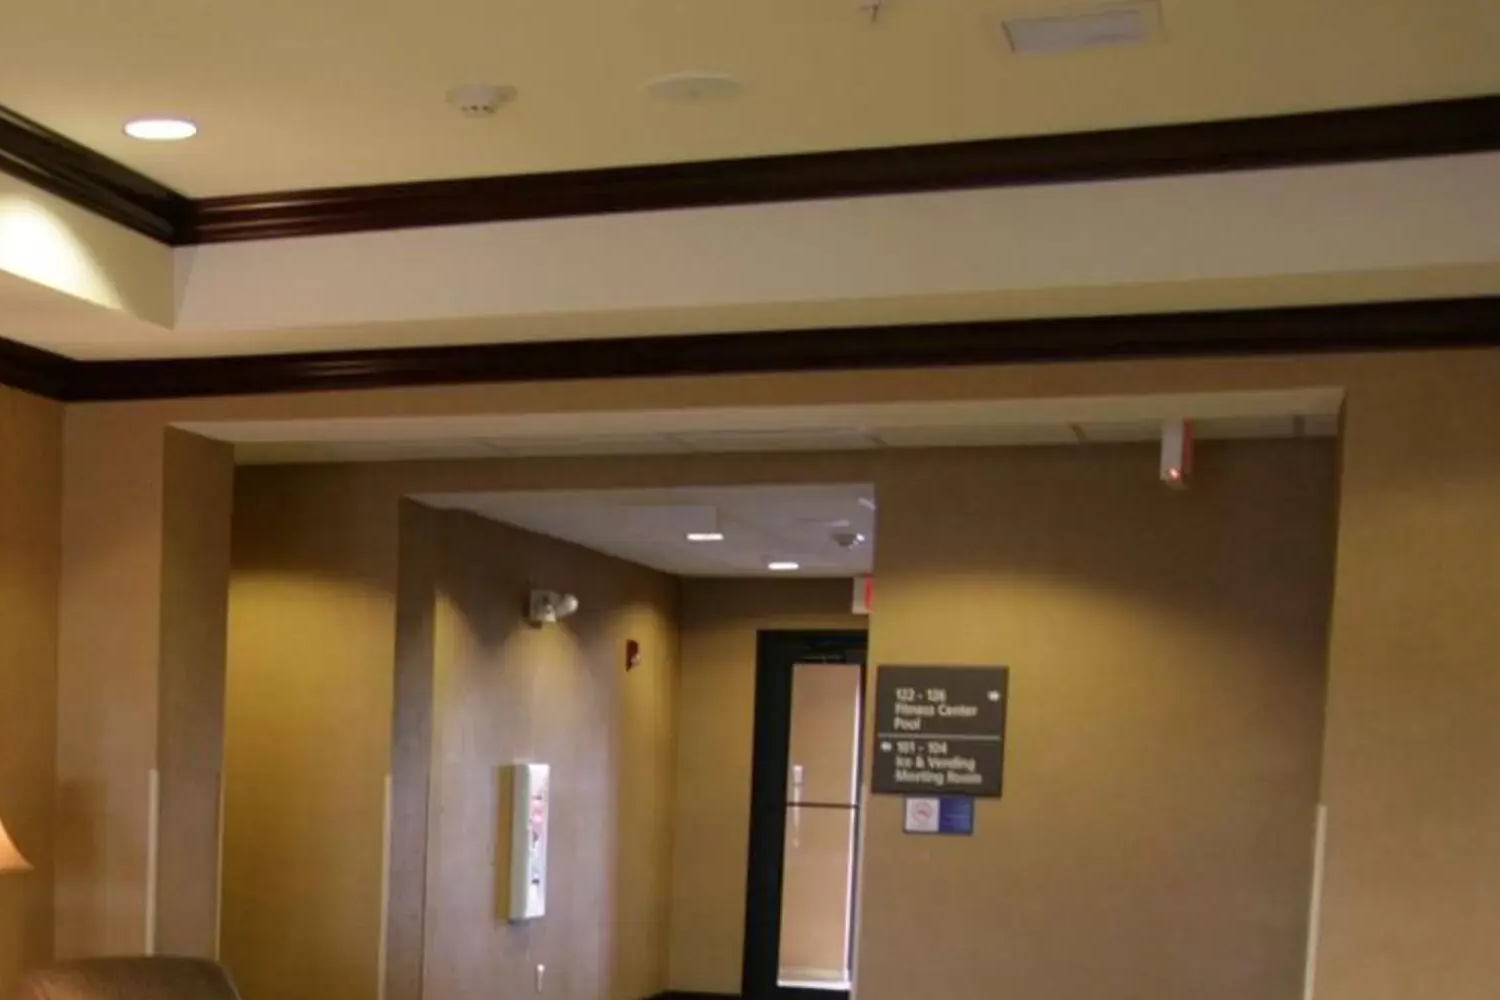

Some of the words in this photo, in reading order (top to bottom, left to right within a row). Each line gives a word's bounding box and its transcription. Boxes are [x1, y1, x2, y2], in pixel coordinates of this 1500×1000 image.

[895, 703, 935, 716] Fitness
[937, 704, 977, 717] Center
[894, 717, 921, 731] Pool
[896, 756, 912, 769] Ice
[916, 756, 925, 768] &
[928, 756, 976, 773] Vending
[896, 770, 944, 786] Meeting
[947, 771, 982, 784] Room
